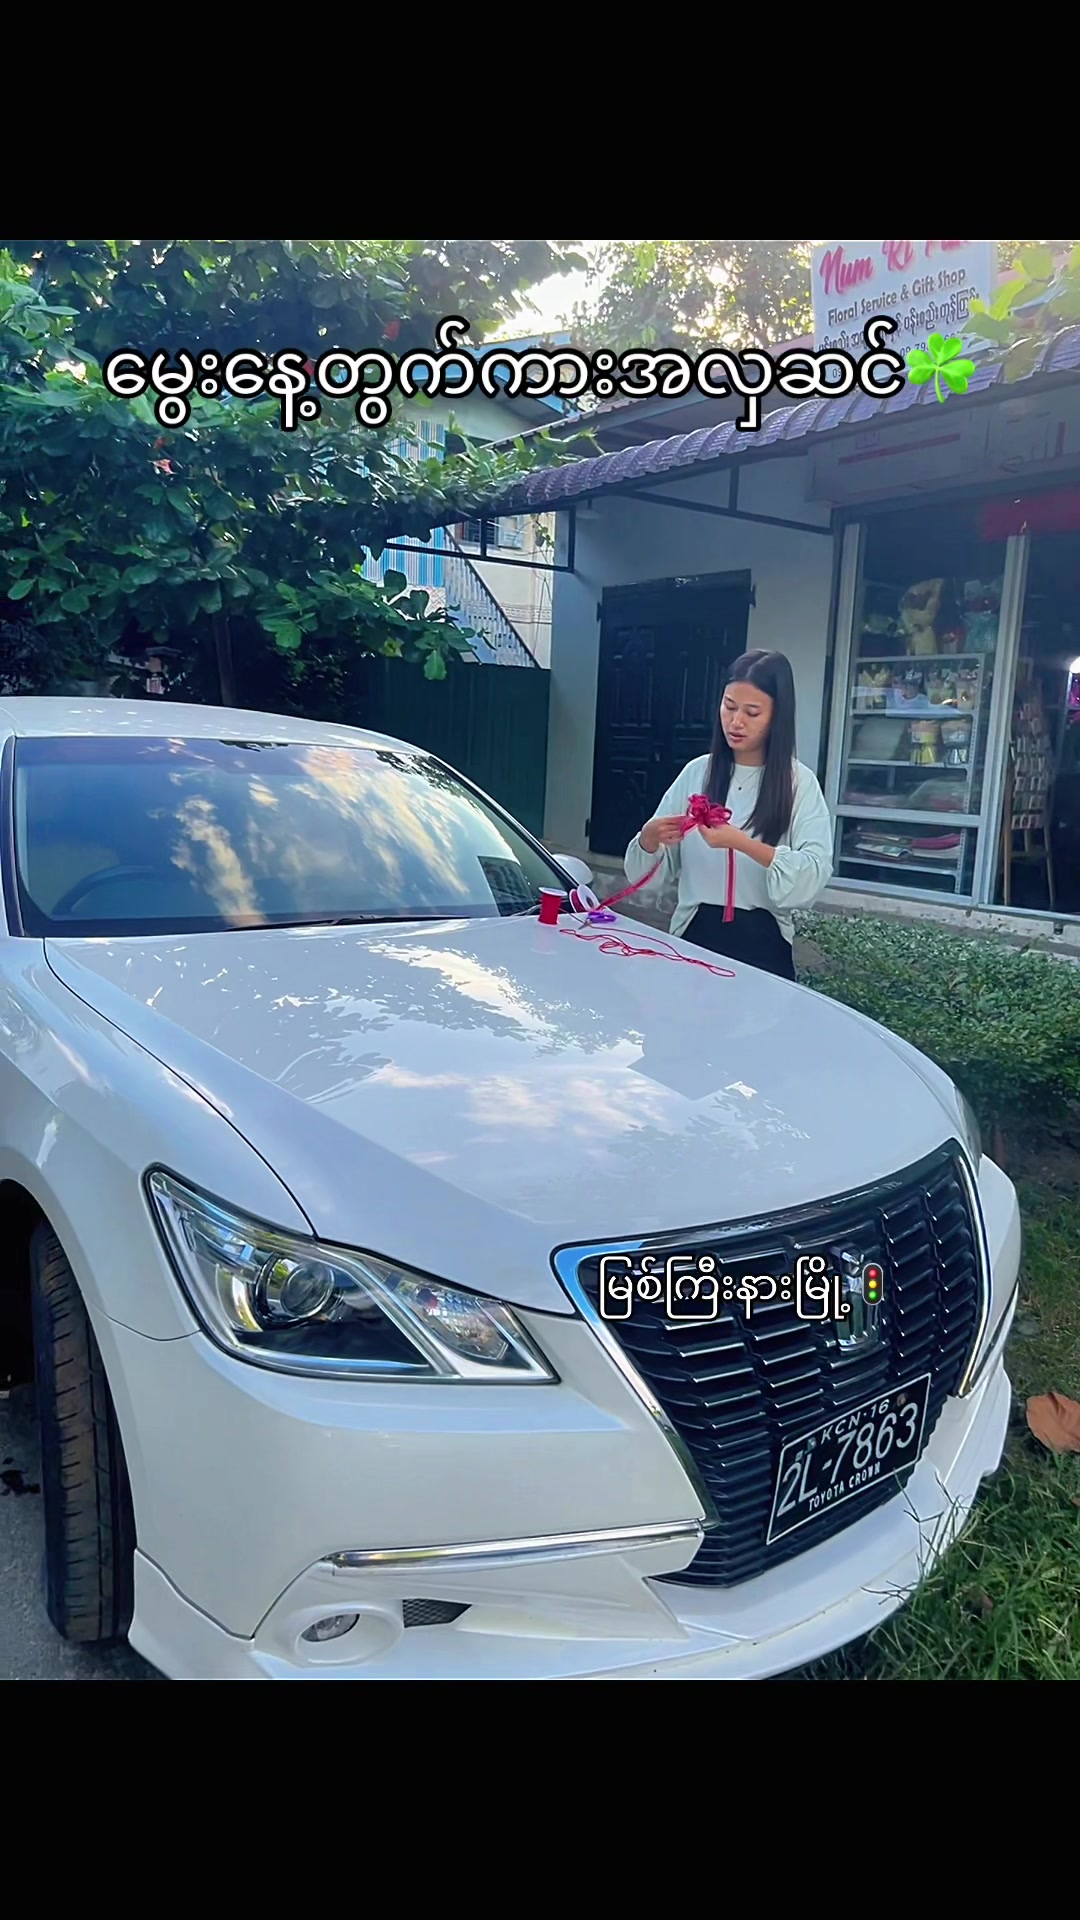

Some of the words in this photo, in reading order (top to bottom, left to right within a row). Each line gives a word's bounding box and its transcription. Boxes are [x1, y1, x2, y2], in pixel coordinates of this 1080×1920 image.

[819, 245, 874, 295] Num
[828, 302, 857, 326] Floral
[861, 292, 897, 315] Service
[900, 284, 909, 301] &
[912, 276, 935, 298] Gift
[938, 269, 966, 289] Shop
[776, 1402, 918, 1518] 2L-7863
[809, 1480, 845, 1512] TOYOTA
[848, 1461, 881, 1489] CROWN
